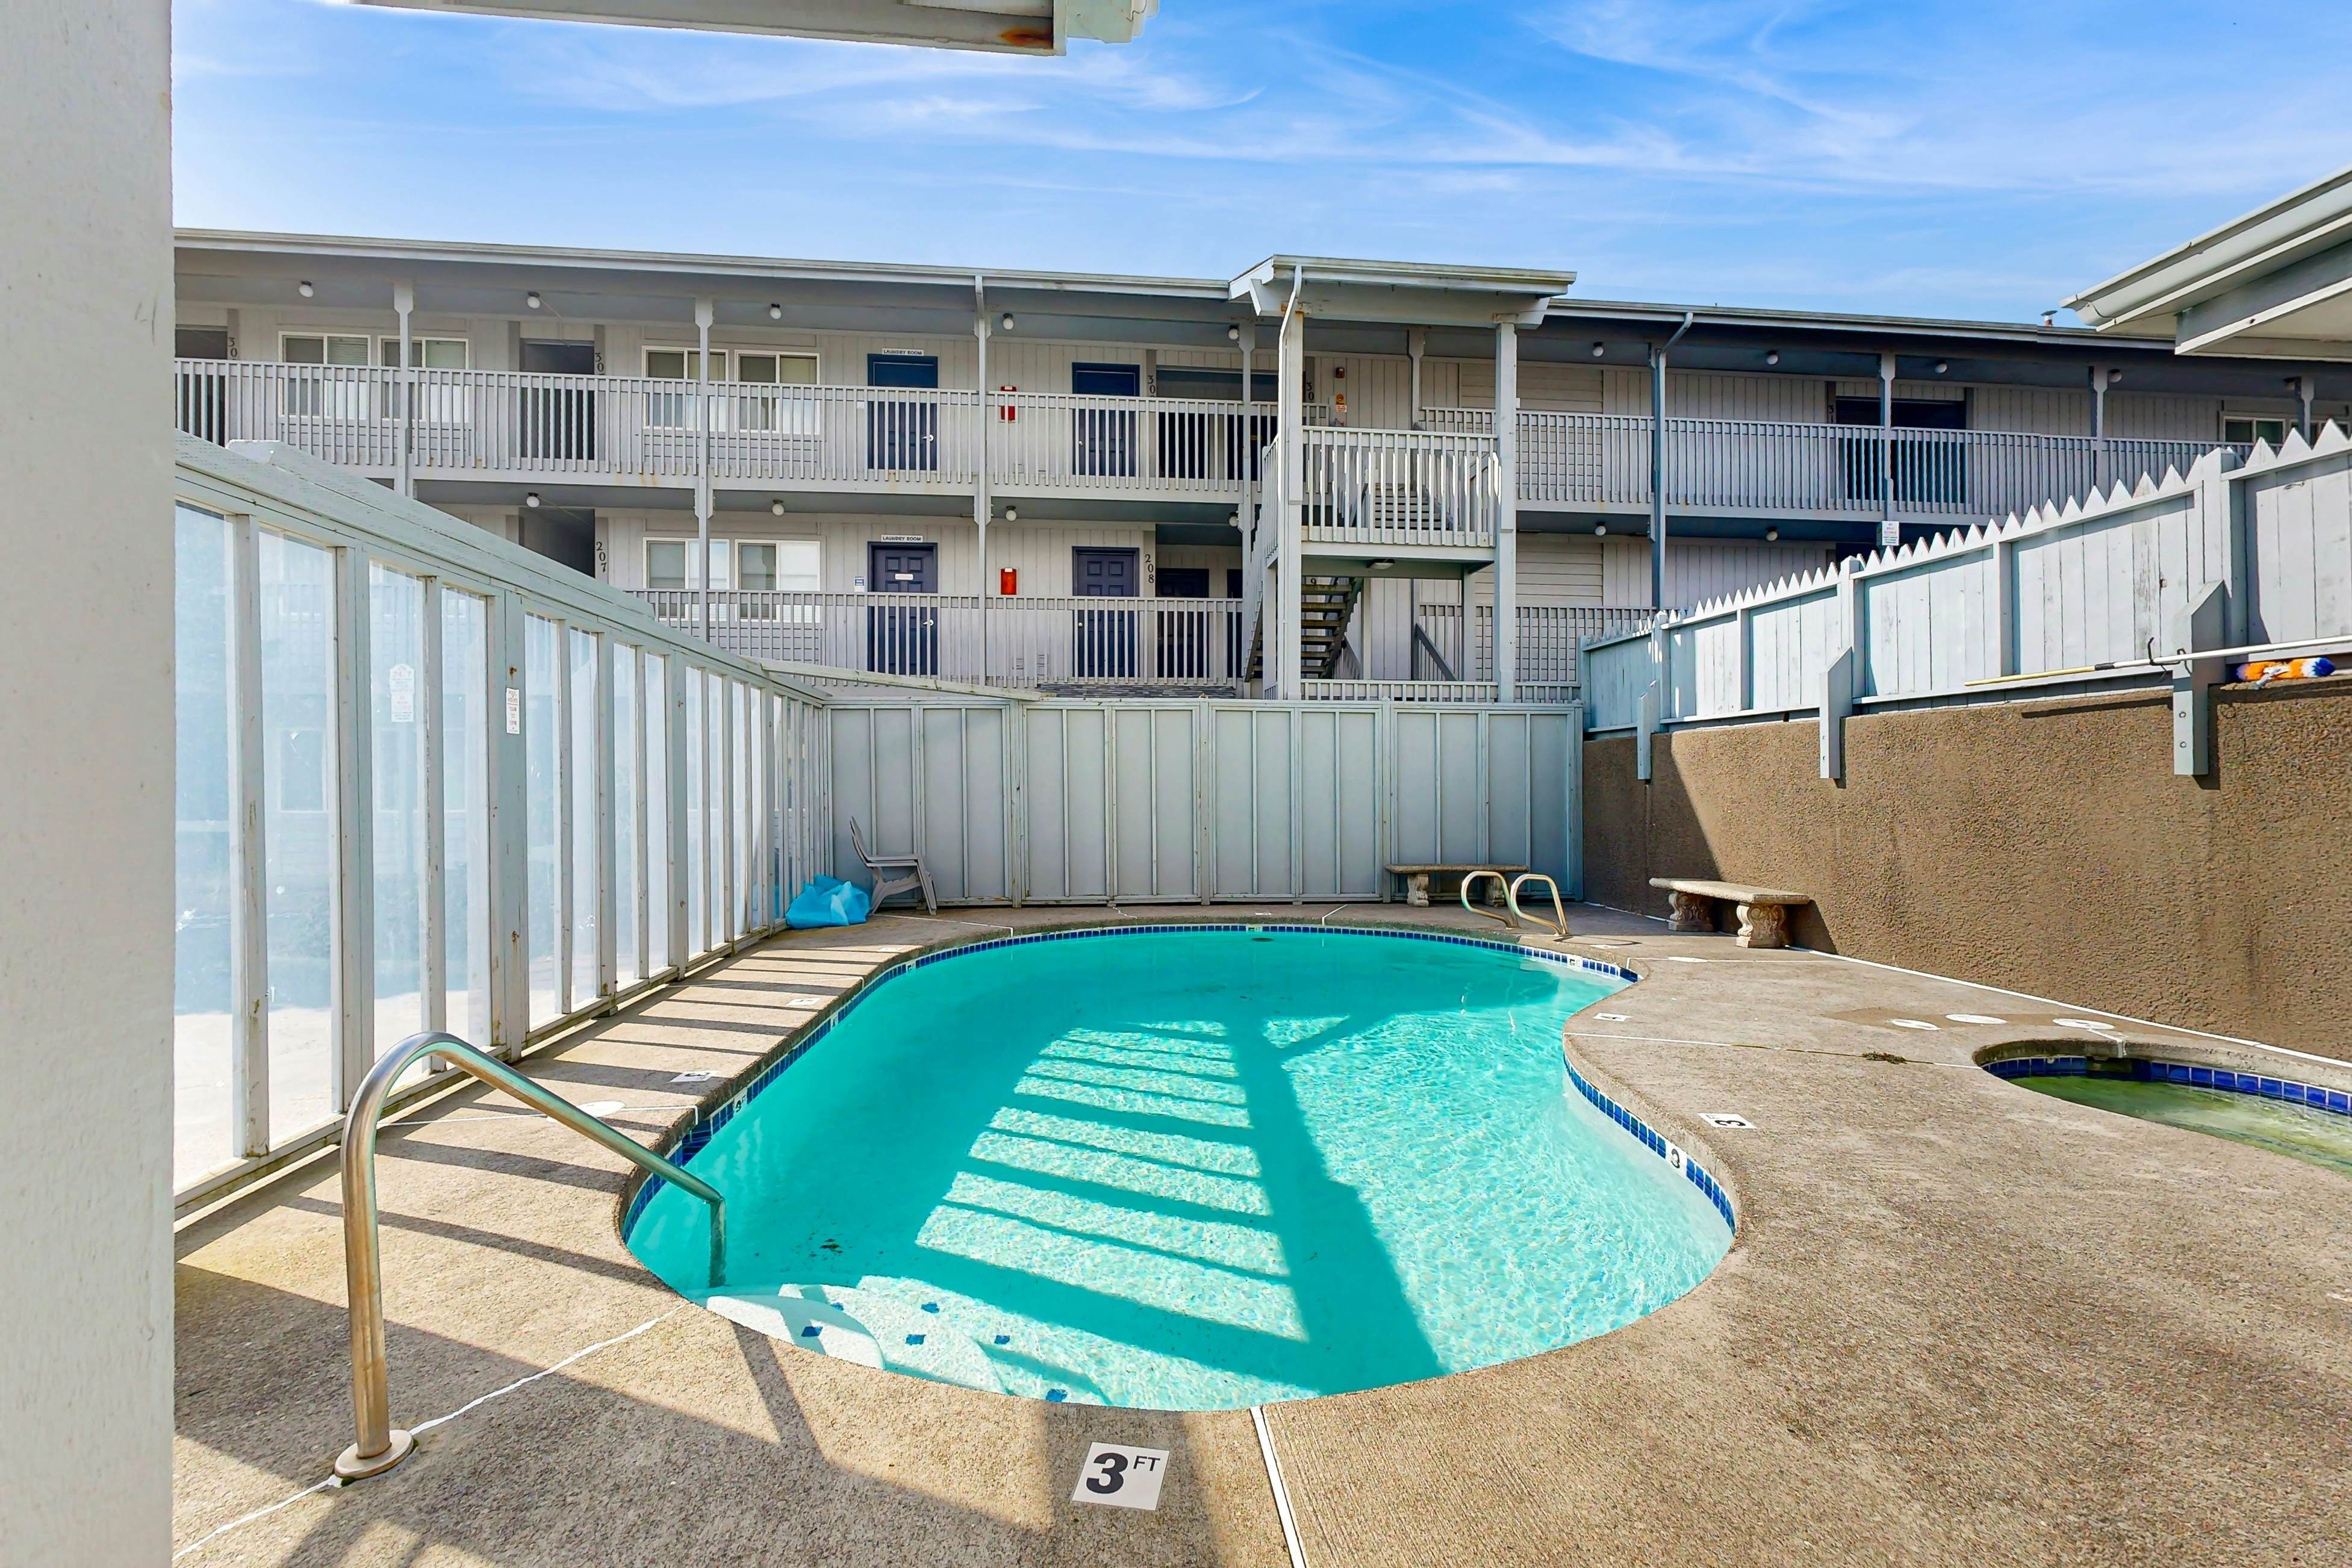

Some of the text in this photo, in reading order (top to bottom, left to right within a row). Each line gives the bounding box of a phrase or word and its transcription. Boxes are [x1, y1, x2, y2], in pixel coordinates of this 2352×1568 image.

[228, 337, 237, 360] 30
[595, 352, 605, 375] 30
[1147, 375, 1156, 397] 30
[1306, 382, 1314, 402] 30
[596, 541, 607, 573] 207
[1145, 554, 1154, 583] 208
[1670, 1148, 1680, 1168] 3
[1086, 1452, 1161, 1495] 3 FT
